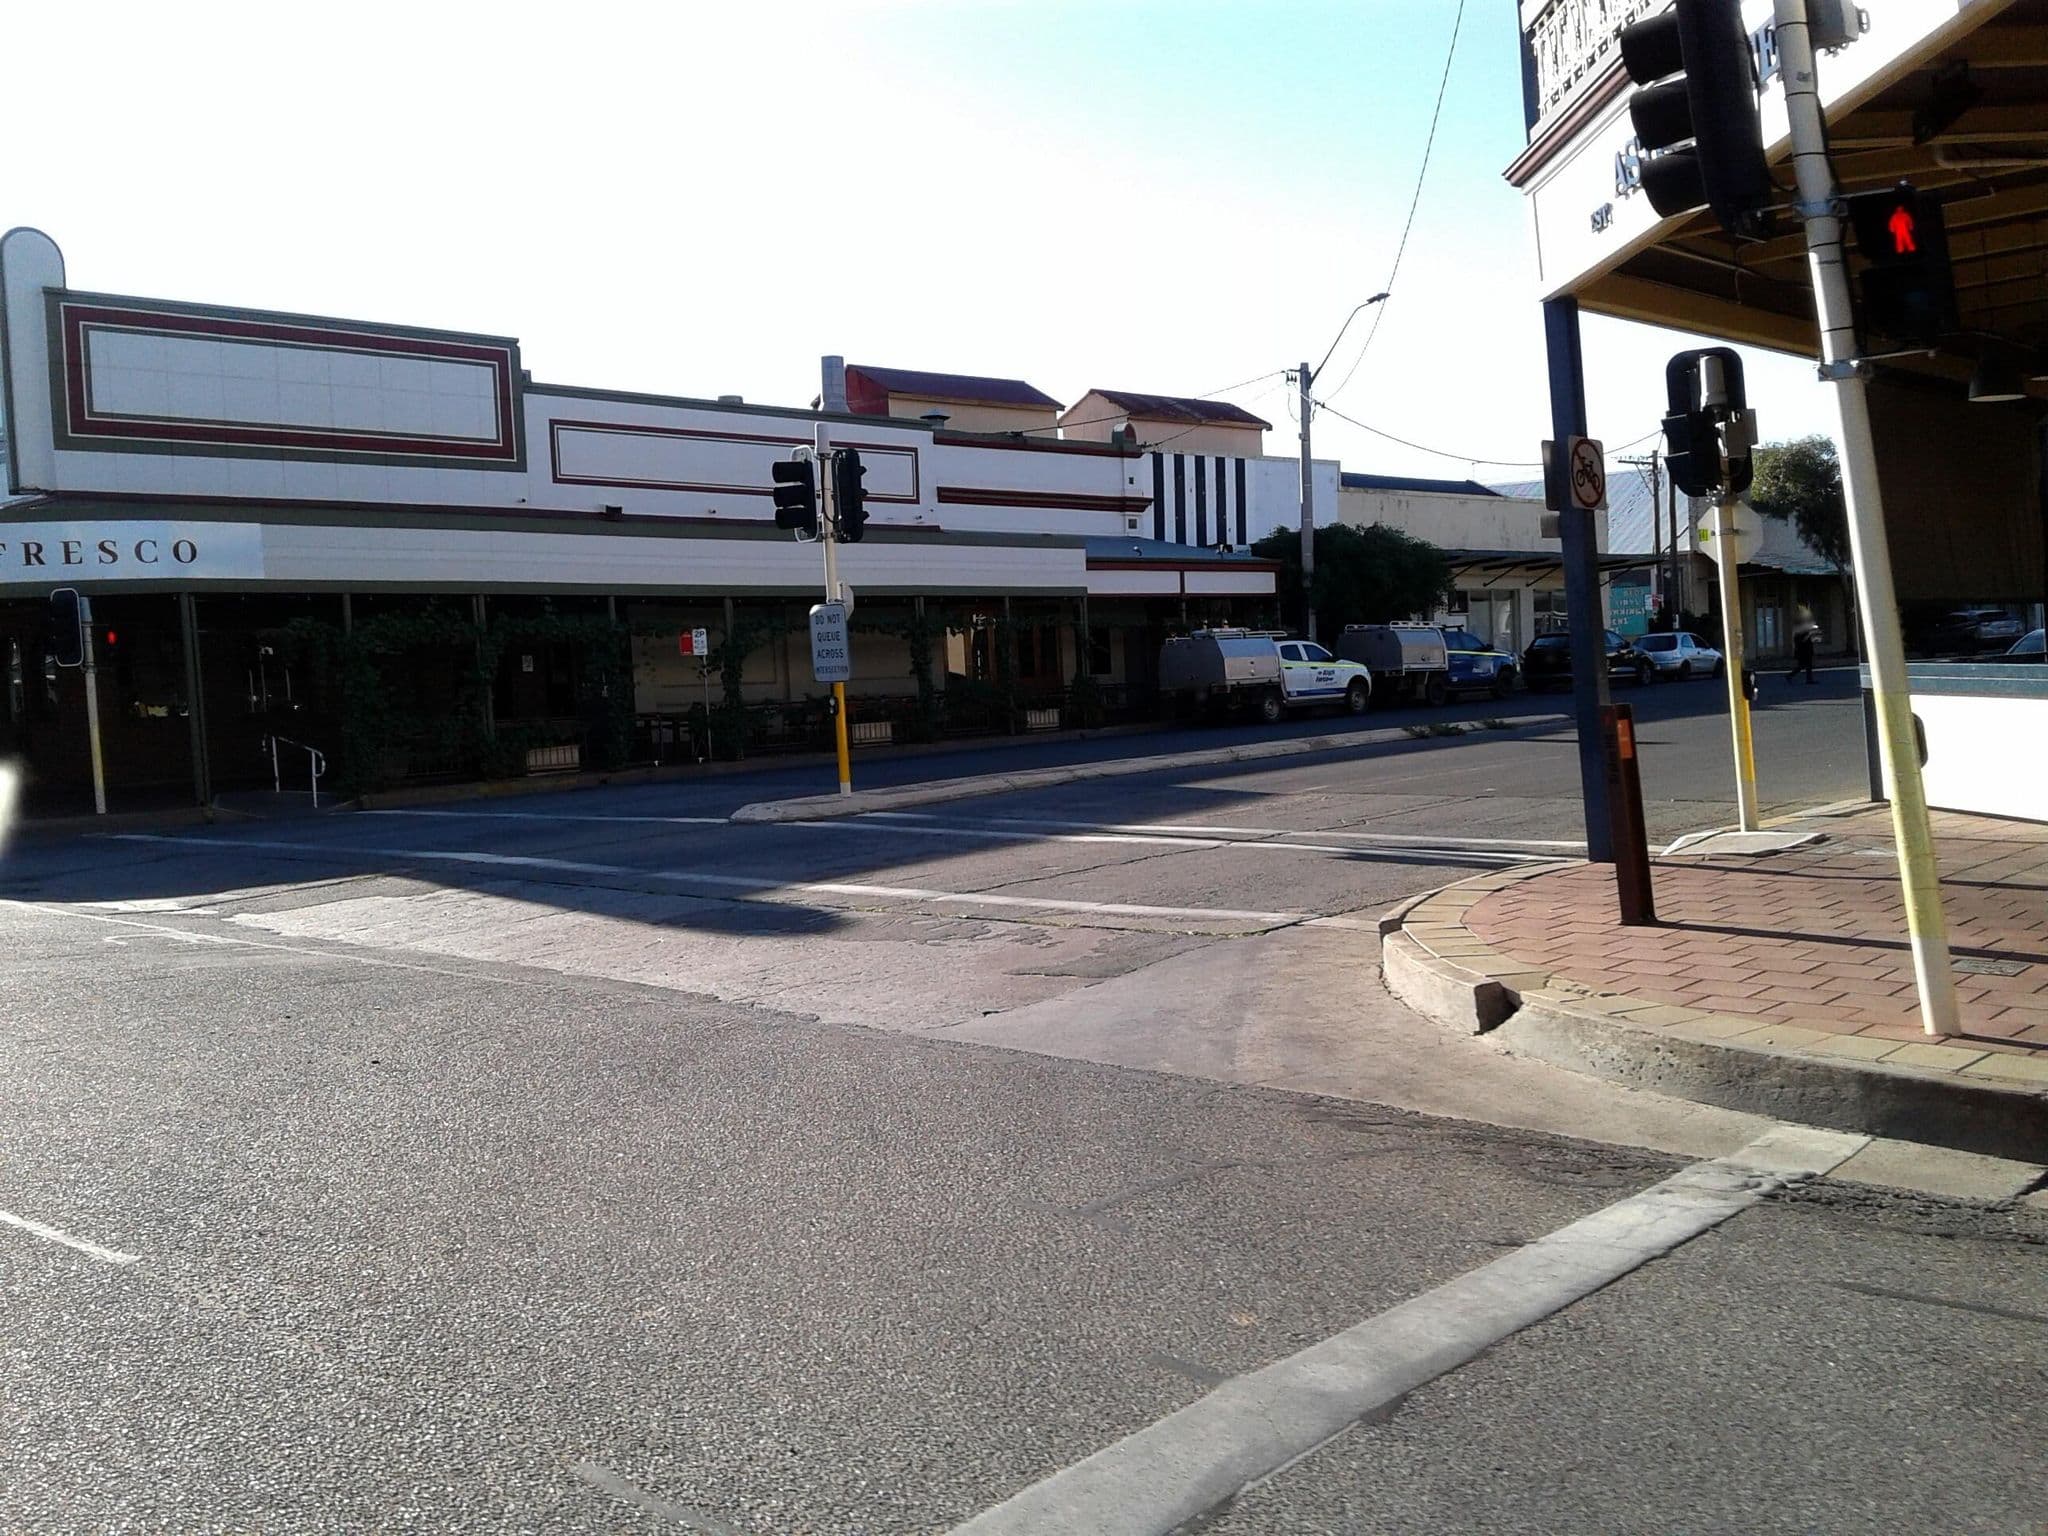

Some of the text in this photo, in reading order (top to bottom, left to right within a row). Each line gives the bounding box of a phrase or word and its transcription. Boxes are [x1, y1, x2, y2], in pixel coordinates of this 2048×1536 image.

[815, 614, 841, 625] DO NOT
[817, 631, 841, 644] QUEUE
[817, 648, 844, 659] ACROSS
